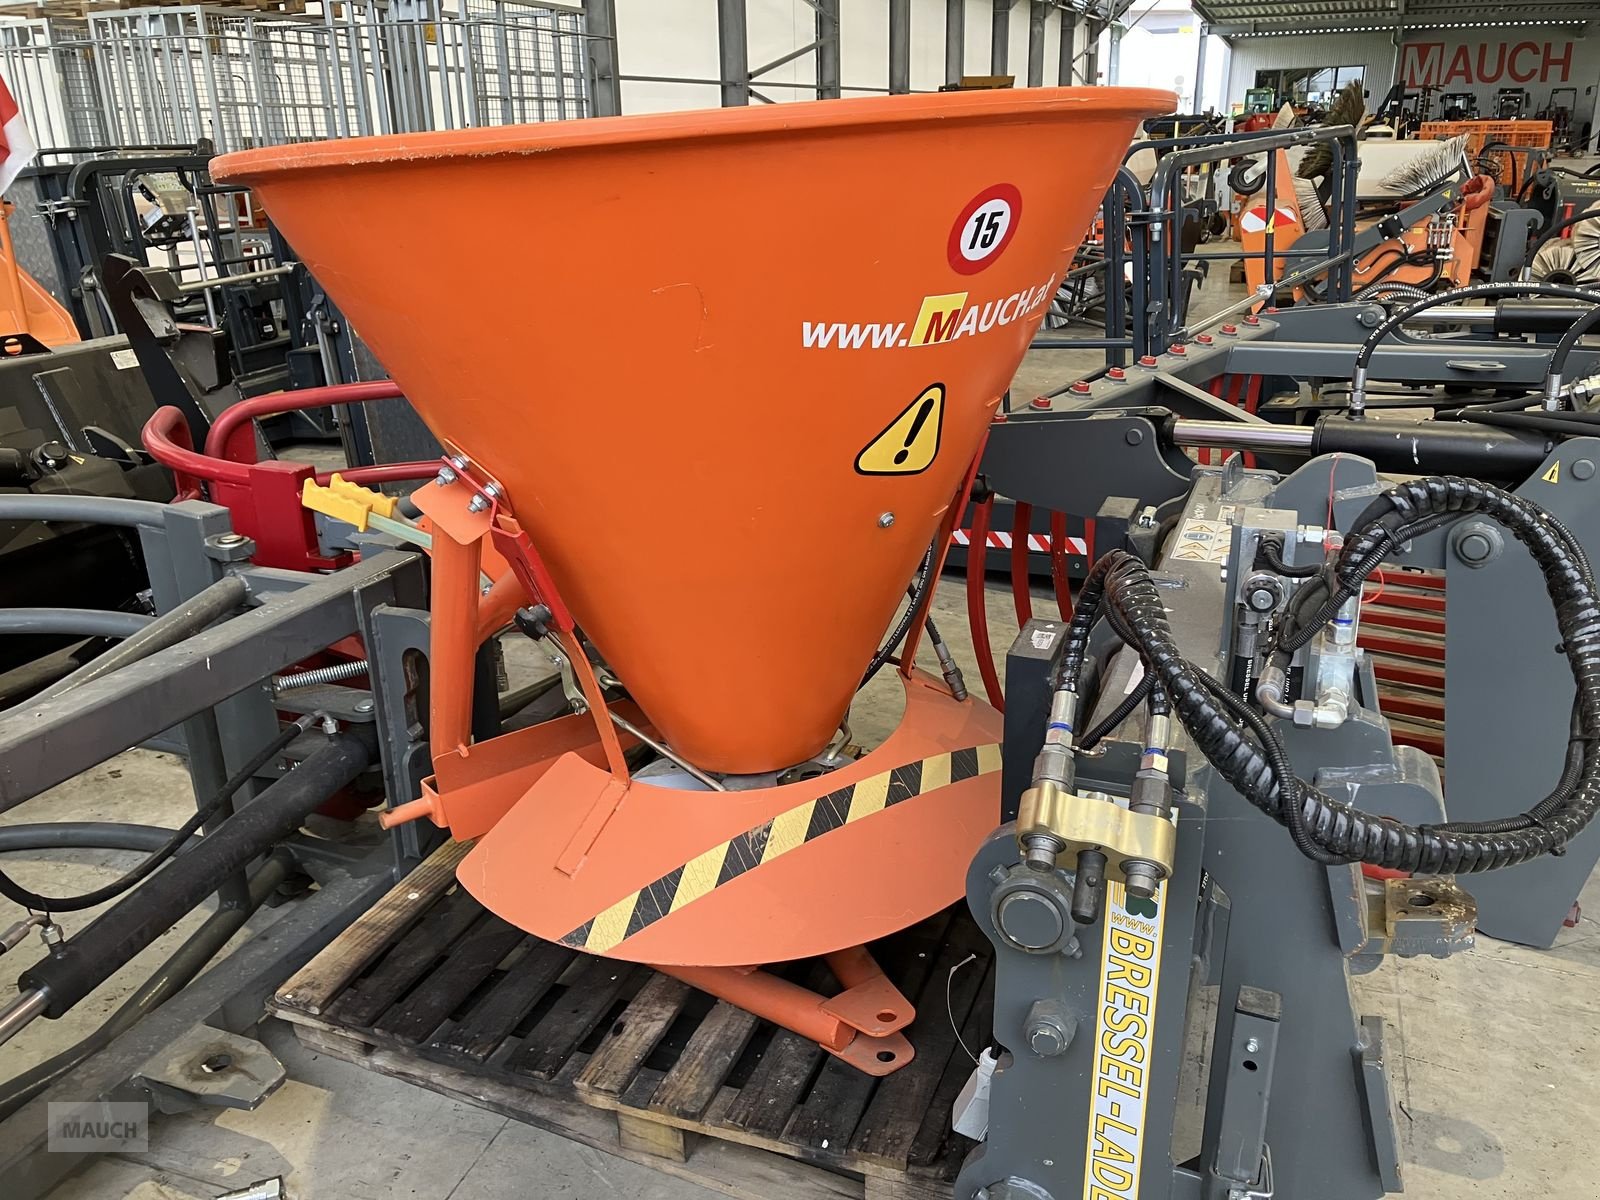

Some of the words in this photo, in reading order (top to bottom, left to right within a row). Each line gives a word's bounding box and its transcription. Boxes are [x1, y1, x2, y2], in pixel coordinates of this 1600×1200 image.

[1400, 41, 1573, 88] MAUCH
[968, 210, 1004, 250] 15
[802, 273, 1055, 348] www.MAUCH.at
[1111, 912, 1158, 938] www.
